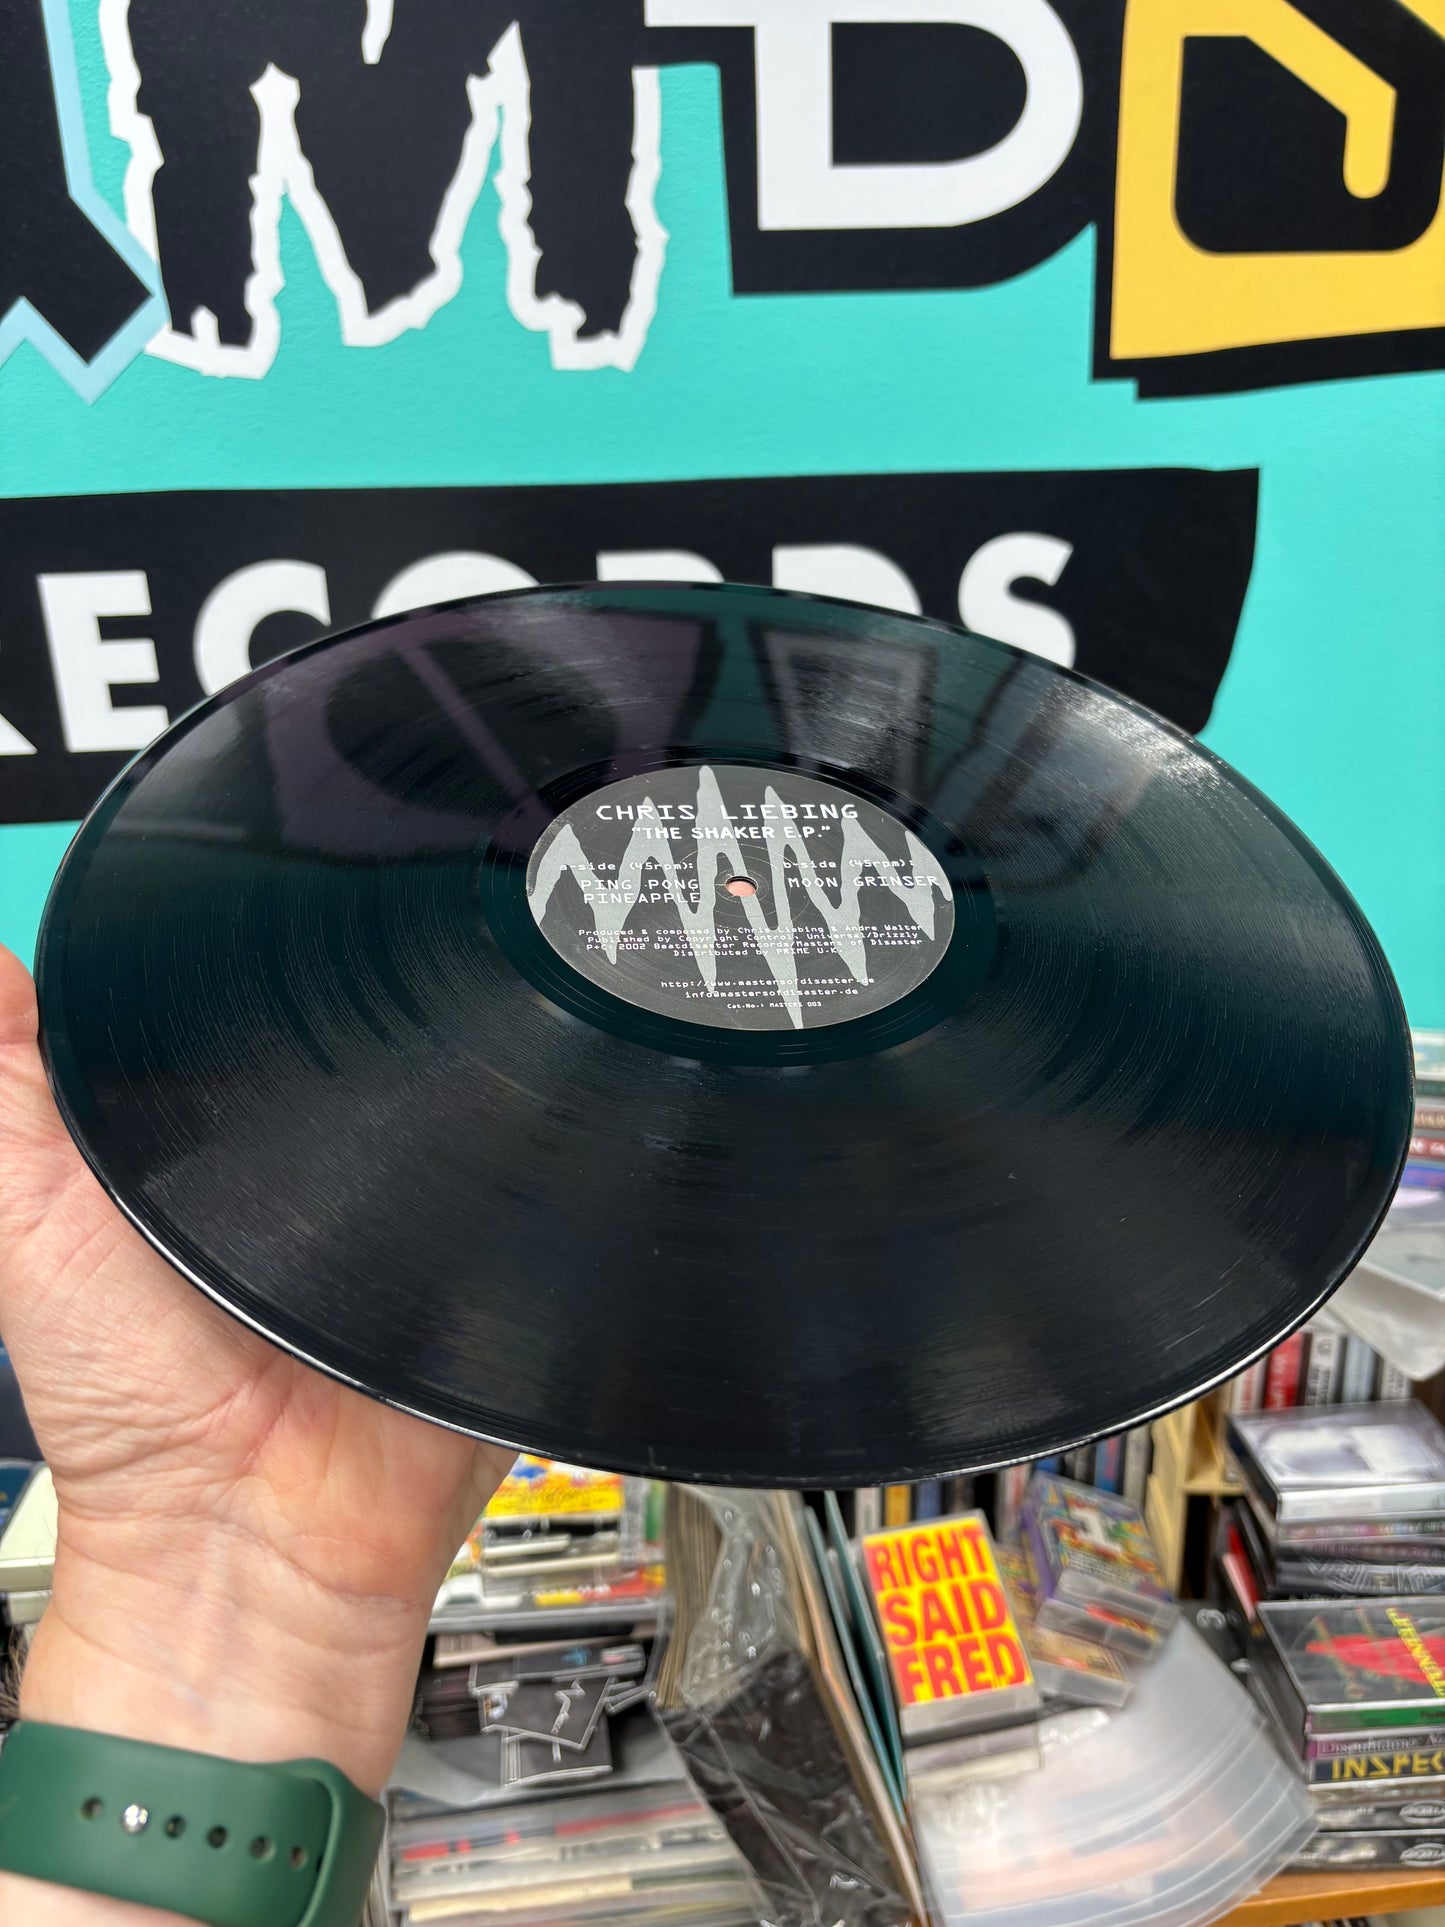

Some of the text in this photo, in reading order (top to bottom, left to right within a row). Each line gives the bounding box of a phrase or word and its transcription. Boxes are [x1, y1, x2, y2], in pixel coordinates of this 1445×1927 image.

[595, 804, 859, 821] CHRIS LIEBING
[691, 826, 775, 840] SHAKER
[559, 861, 694, 871] a-side (45rpm):
[783, 859, 837, 869] b-side
[580, 878, 700, 890] PING PONG
[787, 875, 940, 888] MOON GRINSER
[583, 892, 701, 904] PINEAPPLE
[656, 927, 709, 936] composed
[716, 927, 730, 935] by
[737, 926, 770, 934] Chris
[777, 925, 824, 934] Liebing
[845, 924, 878, 932] Andre
[653, 942, 735, 950] Beatdisaster
[742, 940, 843, 948] Records/Masters
[870, 938, 923, 946] Disaster
[657, 935, 671, 943] by
[678, 934, 739, 943] Copyright
[673, 949, 748, 957] Distributed
[755, 948, 769, 956] by
[776, 947, 810, 955] PRIME
[685, 988, 859, 999] info@mastersofdisaster.de
[864, 1524, 987, 1592] RIGHT
[884, 1580, 1007, 1647] SAID
[895, 1633, 1026, 1705] FRED
